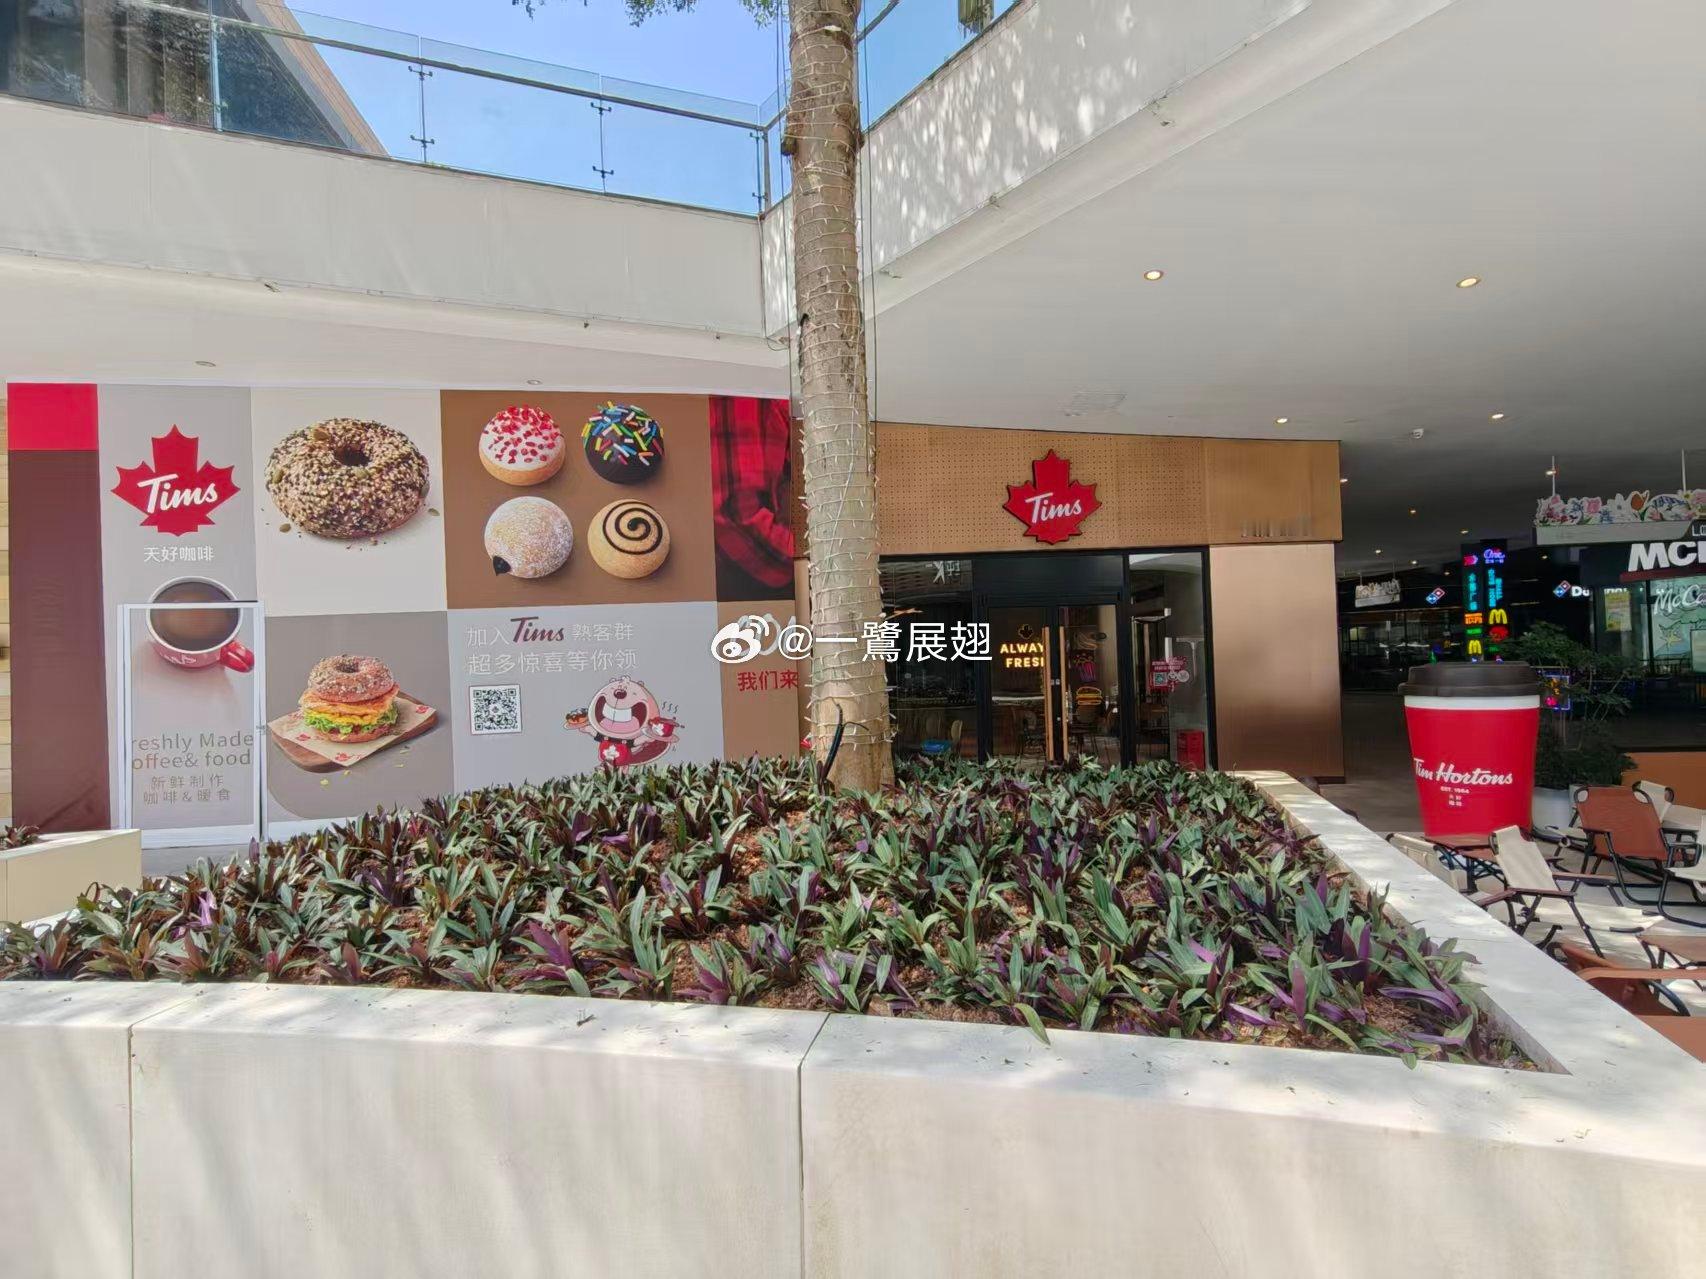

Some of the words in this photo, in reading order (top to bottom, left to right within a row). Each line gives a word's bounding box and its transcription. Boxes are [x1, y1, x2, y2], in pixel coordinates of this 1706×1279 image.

[137, 473, 218, 514] Tims
[1024, 492, 1082, 524] Tims
[143, 545, 215, 562] 天好咖啡
[466, 626, 510, 648] 加入
[510, 616, 564, 643] Tims
[572, 622, 634, 641] 熟客群
[1000, 642, 1044, 654] ALWAY
[467, 649, 639, 676] 超多惊喜等你领
[737, 670, 798, 692] 我们来
[132, 733, 192, 753] reshly
[200, 730, 253, 748] Made
[132, 752, 199, 770] offee&
[205, 749, 251, 767] food
[1413, 757, 1433, 780] Tim
[1436, 762, 1513, 785] Hortons
[151, 774, 224, 790] 新鲜制作
